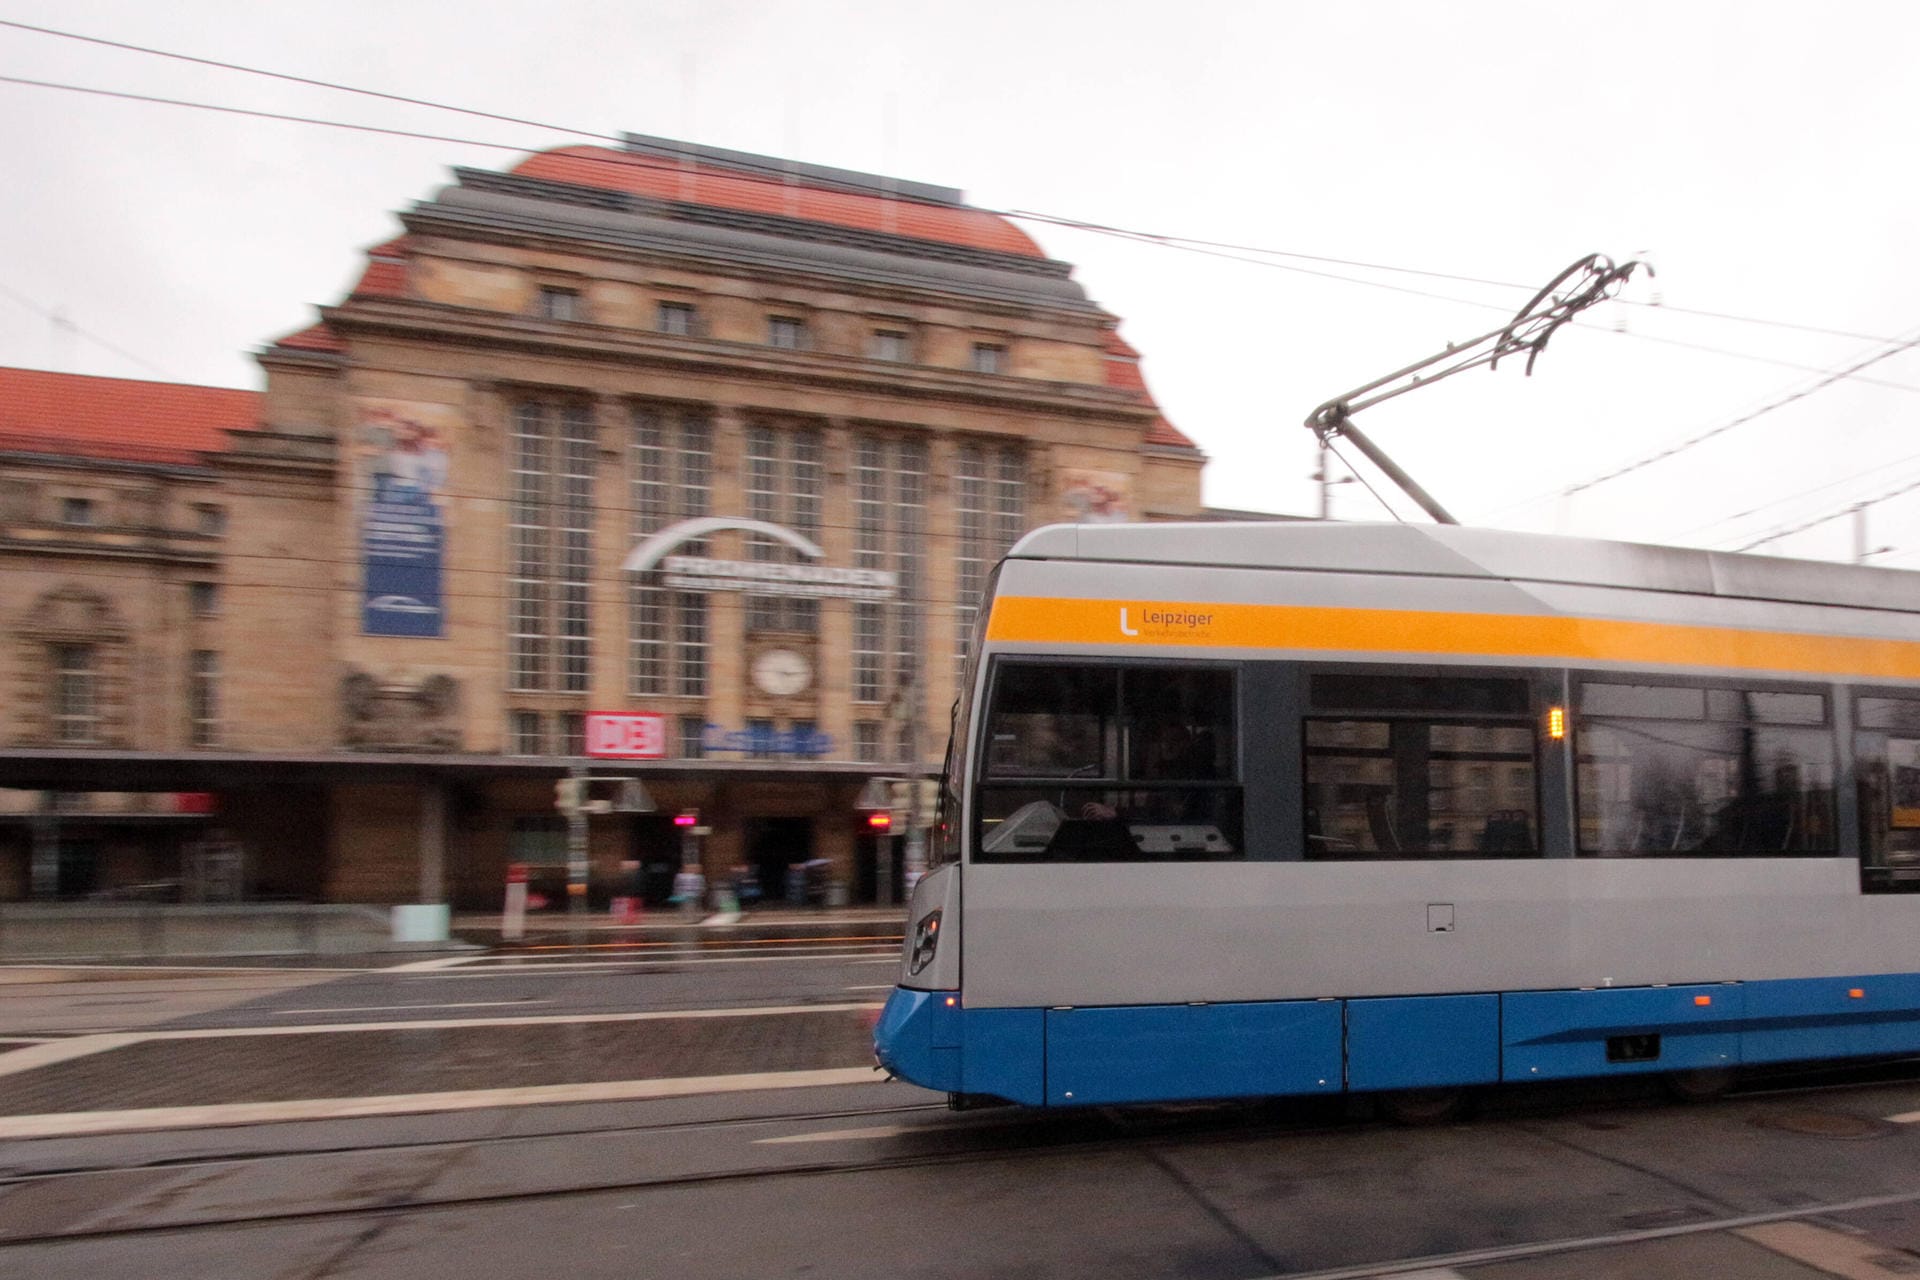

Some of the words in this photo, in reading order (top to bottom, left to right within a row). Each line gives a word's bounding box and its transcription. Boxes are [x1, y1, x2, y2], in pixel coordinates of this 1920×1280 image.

[1120, 607, 1139, 636] L
[1143, 608, 1213, 628] Leipziger
[595, 718, 656, 751] DB
